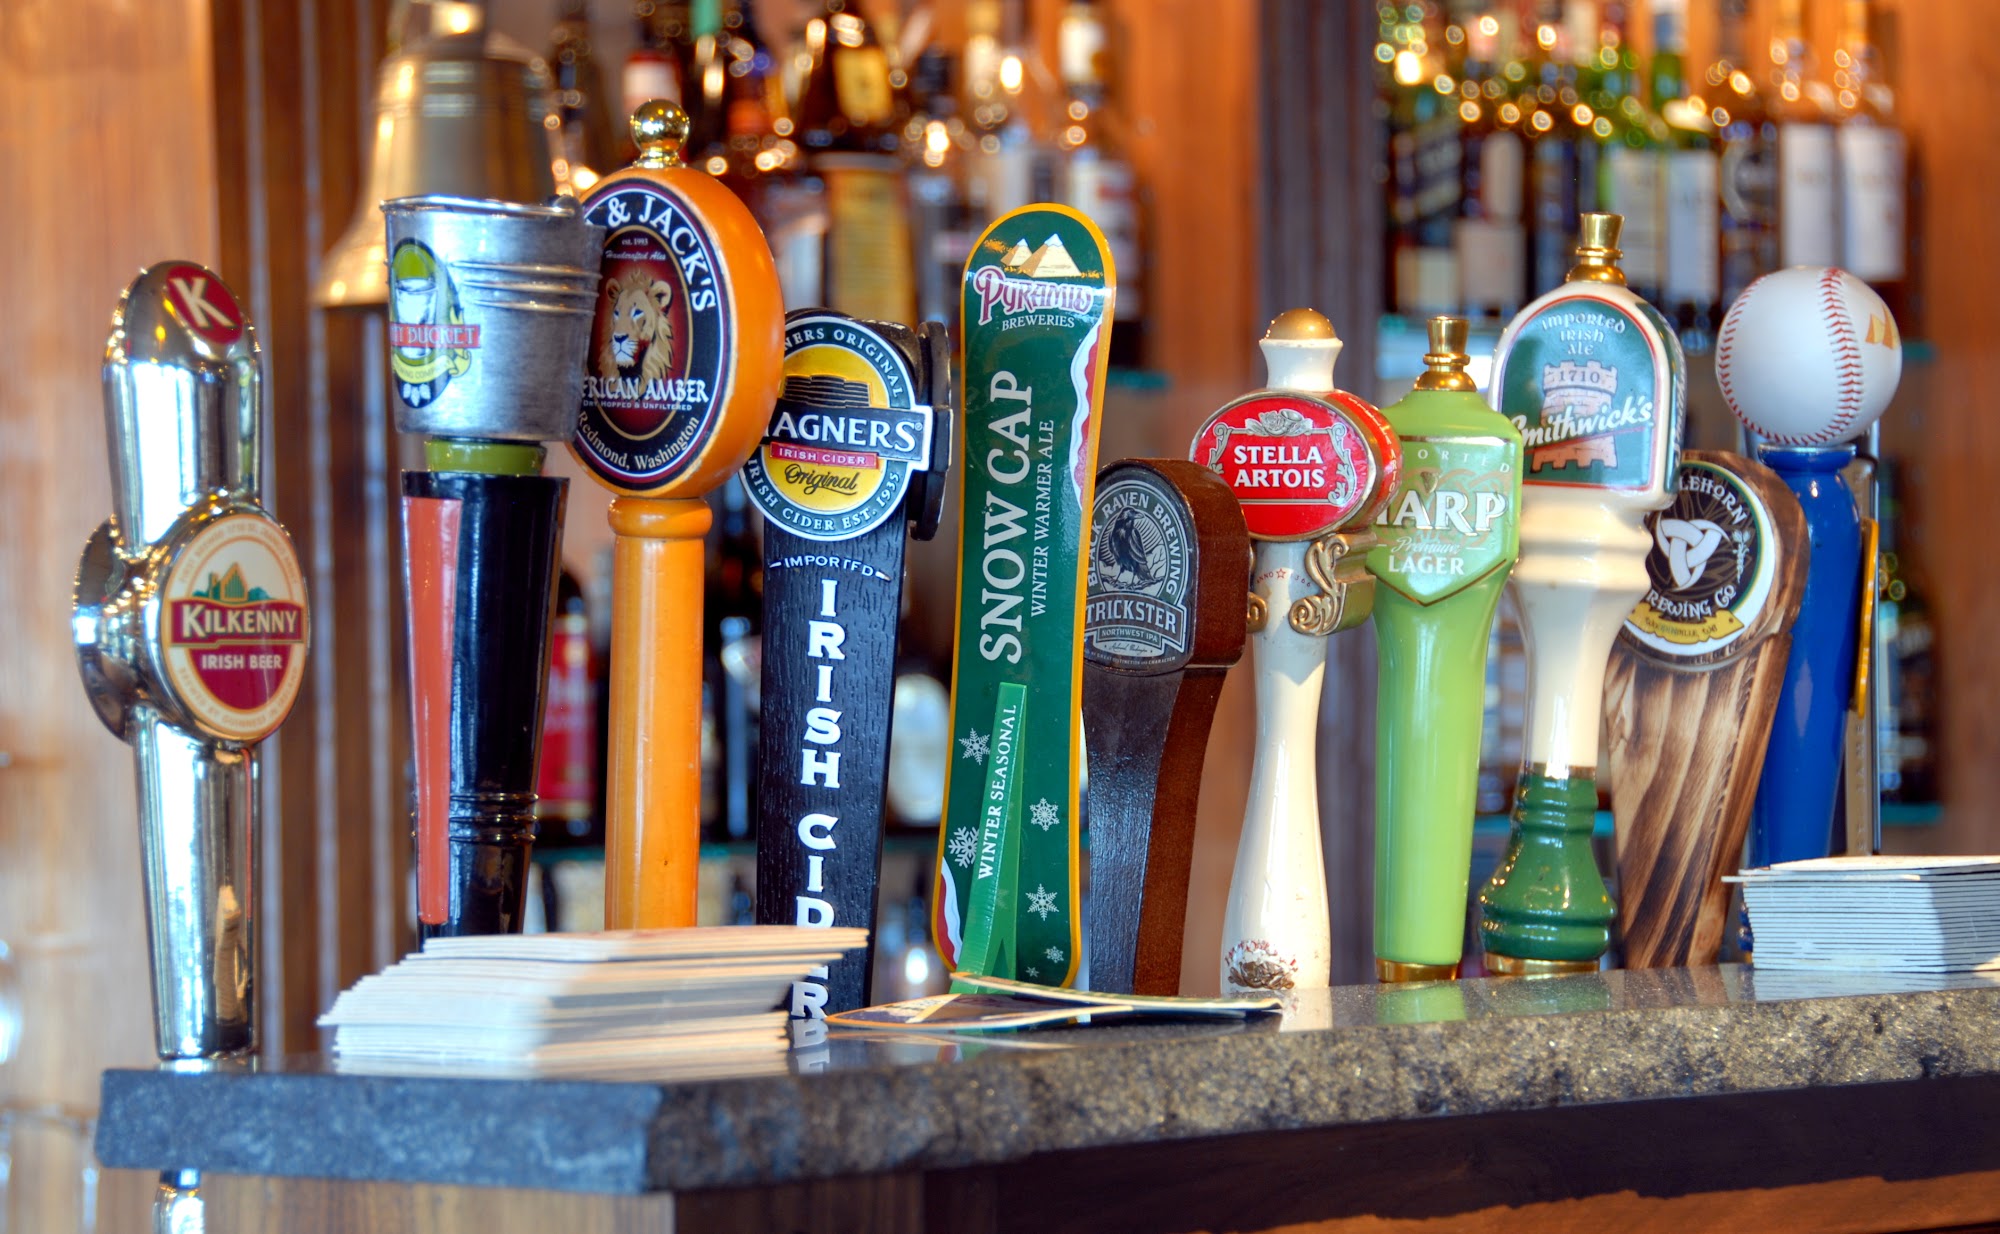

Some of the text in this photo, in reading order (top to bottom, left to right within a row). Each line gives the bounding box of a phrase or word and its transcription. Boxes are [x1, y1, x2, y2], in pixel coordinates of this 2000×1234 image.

[605, 250, 648, 261] Handcrafted
[608, 195, 716, 311] & JACK'S
[170, 277, 233, 328] K
[408, 325, 475, 344] BUCKET
[1002, 314, 1075, 331] BREWERIES
[785, 328, 903, 397] NERS ORIGINAL
[582, 376, 709, 403] FRICAN AMBER
[1559, 371, 1600, 384] 1710
[643, 403, 692, 411] UNFILTERED
[578, 411, 699, 470] Redmond, Washington
[1234, 445, 1323, 465] STELLA
[779, 449, 866, 465] IRISH CIDER
[1418, 449, 1510, 473] ORTED
[785, 464, 860, 495] Original
[1234, 469, 1325, 488] ARTOIS
[749, 459, 899, 530] IRISH CIDER EST. 1935
[1679, 476, 1746, 525] LEHORN
[980, 370, 1032, 664] SNOW CAP
[1031, 419, 1054, 617] WINTER WARMER ALE
[1088, 491, 1183, 596] BLACK RAVEN BREWING
[1391, 536, 1461, 554] Premium
[1257, 571, 1273, 584] ANNO
[1388, 556, 1464, 574] LAGER
[1086, 600, 1176, 634] TRICKSTER
[1646, 589, 1712, 620] REWING
[182, 604, 297, 638] KILKENNY
[1102, 628, 1158, 642] NORTHWEST IPA
[201, 654, 282, 669] IRISH BEER
[800, 578, 847, 789] IRISH
[978, 704, 1016, 880] WINTER SEASONAL
